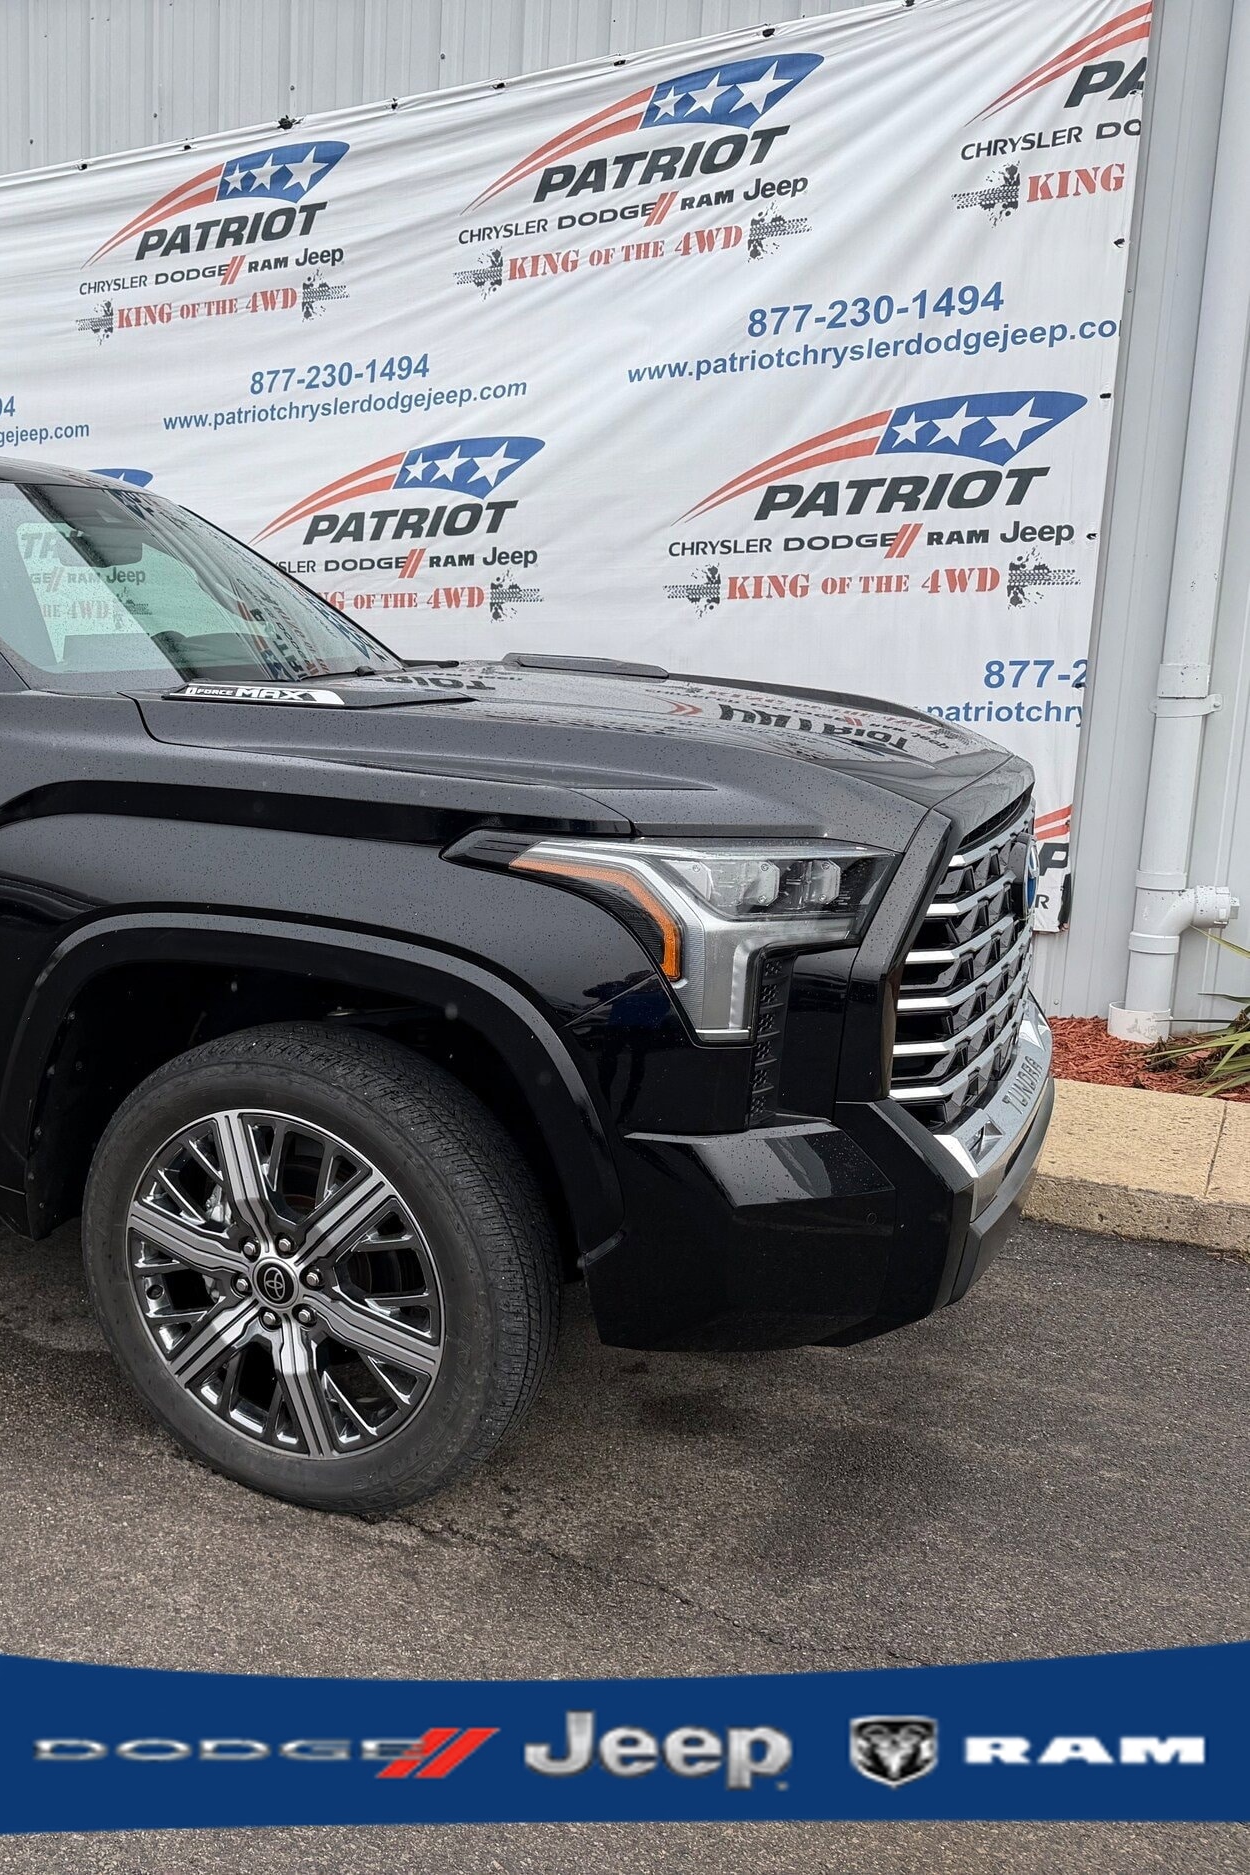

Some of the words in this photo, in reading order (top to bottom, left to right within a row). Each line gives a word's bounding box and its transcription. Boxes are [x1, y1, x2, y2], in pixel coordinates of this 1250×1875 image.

[533, 125, 790, 203] PATRIOT
[961, 126, 1083, 160] CHRYSLER
[1027, 163, 1125, 202] KING
[135, 202, 328, 260] PATRIOT
[459, 219, 548, 245] CHRYSLER
[557, 202, 655, 230] DODGE
[680, 189, 734, 211] RAM
[743, 176, 808, 201] Jeep
[79, 276, 148, 296] CHRYSLER
[154, 264, 229, 286] DODGE
[248, 256, 288, 273] RAM
[296, 248, 344, 267] Jeep
[508, 248, 580, 280] KING
[589, 248, 615, 266] OF
[621, 240, 665, 262] THE
[674, 226, 743, 256] 4WD
[118, 302, 172, 328] KING
[180, 303, 200, 320] OF
[201, 298, 238, 317] THE
[246, 287, 297, 312] 4WD
[747, 281, 1004, 338] 877-230-1494
[628, 319, 1122, 383] www.patriotchryslerdodgejeep.co
[250, 353, 430, 395] 877-230-1494
[163, 382, 527, 431] www.patriotchryslerdodgejeep.com
[754, 466, 1050, 521] PATRIOT
[302, 500, 518, 545] PATRIOT
[668, 538, 772, 557] CHRYSLER
[783, 533, 897, 552] DODGE
[927, 529, 990, 546] RAM
[1000, 521, 1075, 546] Jeep
[106, 567, 146, 585] Jeep
[275, 560, 316, 573] SLER
[324, 556, 408, 572] DODGE
[430, 554, 474, 568] RAM
[483, 547, 538, 568] Jeep
[354, 594, 376, 610] OF
[381, 592, 418, 609] THE
[426, 587, 484, 609] 4WD
[727, 573, 810, 600] KING
[822, 576, 853, 594] OF
[859, 574, 910, 594] THE
[922, 567, 1001, 594] 4WD
[236, 688, 303, 700] MAX
[1002, 1056, 1044, 1115] TUNDRA
